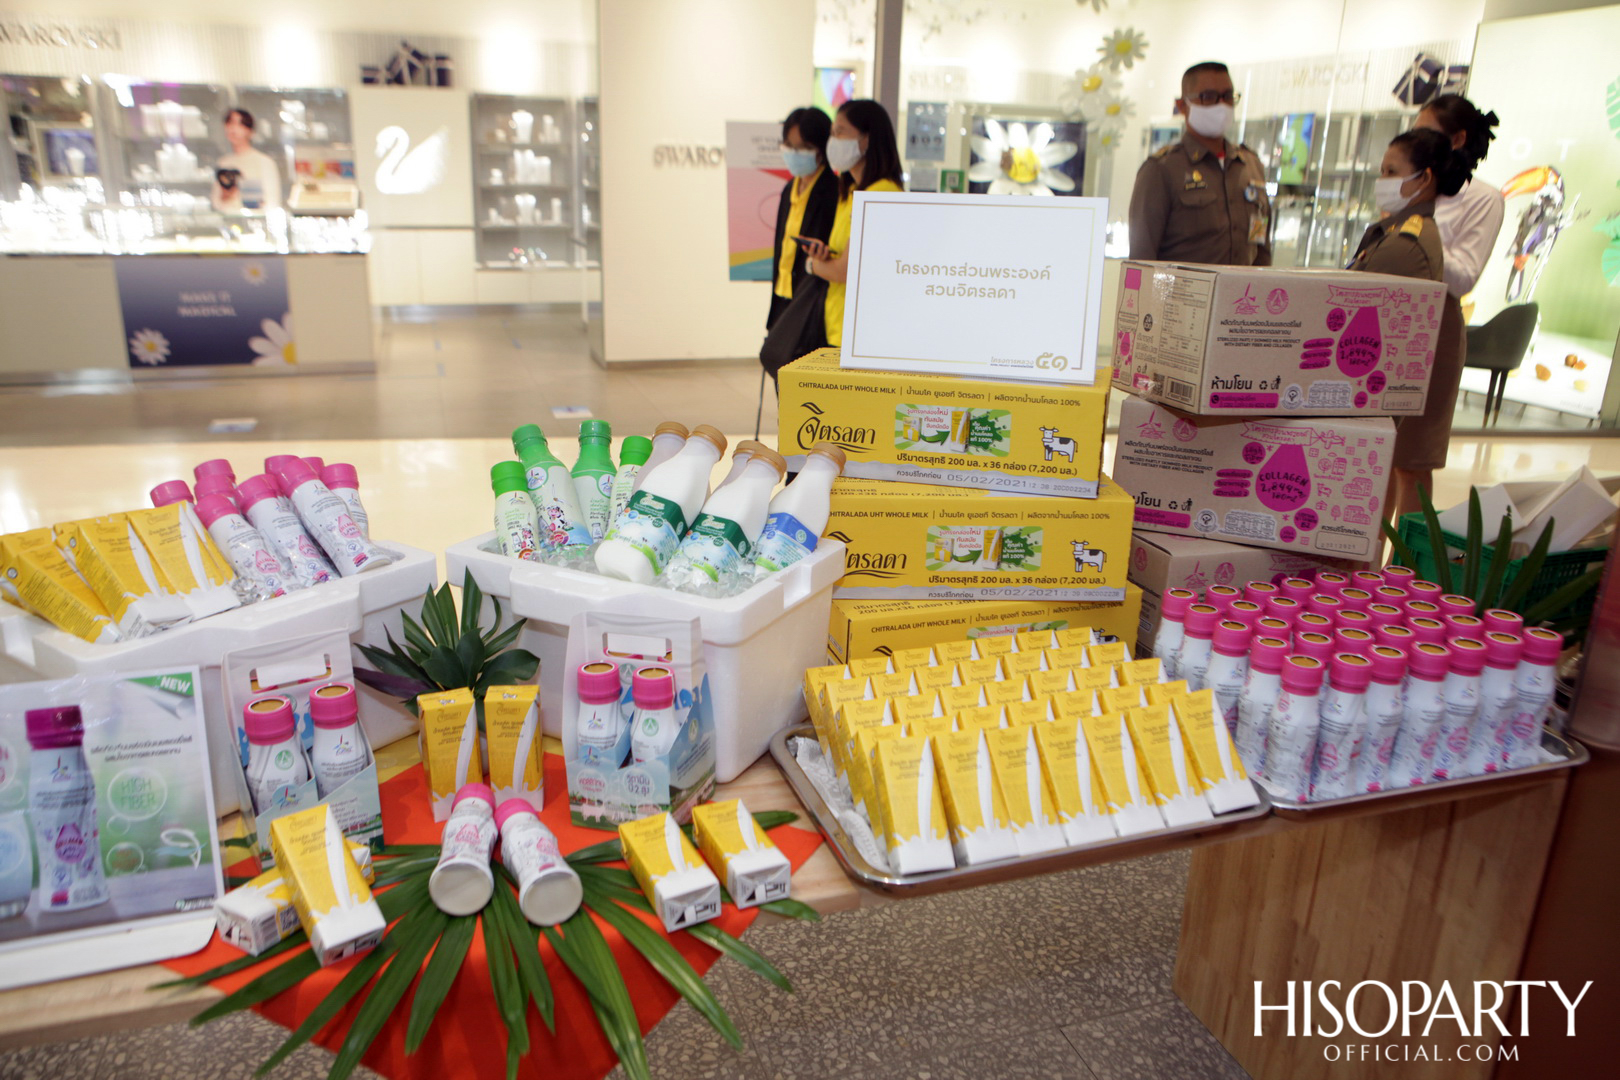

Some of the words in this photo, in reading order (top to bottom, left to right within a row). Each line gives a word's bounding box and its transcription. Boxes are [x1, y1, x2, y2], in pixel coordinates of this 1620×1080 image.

[653, 145, 726, 169] SWARO
[896, 260, 1052, 281] โครงการส่วนพระองค์
[924, 282, 1017, 300] สวนจิตรลดา
[1340, 336, 1379, 349] COLLAGEN
[798, 382, 839, 390] CHITRALADA
[1211, 374, 1253, 390] ห้ามโยน
[958, 390, 985, 400] จิตรลดา
[948, 458, 965, 466] 200
[967, 460, 981, 468] มล.
[990, 460, 1001, 469] 36
[1003, 460, 1027, 471] กล่อง
[1028, 464, 1058, 474] (7,200
[1060, 467, 1078, 476] มล.)
[947, 473, 1027, 488] 05/02/2021
[1260, 471, 1308, 487] COLLAGEN
[1262, 482, 1293, 493] 2,844
[1133, 492, 1161, 508] มโยน
[991, 510, 1018, 519] จิตรลดา
[1035, 576, 1058, 584] กล่อง
[1060, 577, 1087, 585] (7,200
[1089, 577, 1106, 585] มล.)
[981, 588, 1058, 596] 05/02/2021
[872, 623, 911, 633] CHITRALADA
[160, 676, 191, 693] NEW
[121, 777, 152, 792] HIGH
[120, 793, 155, 811] FIBER
